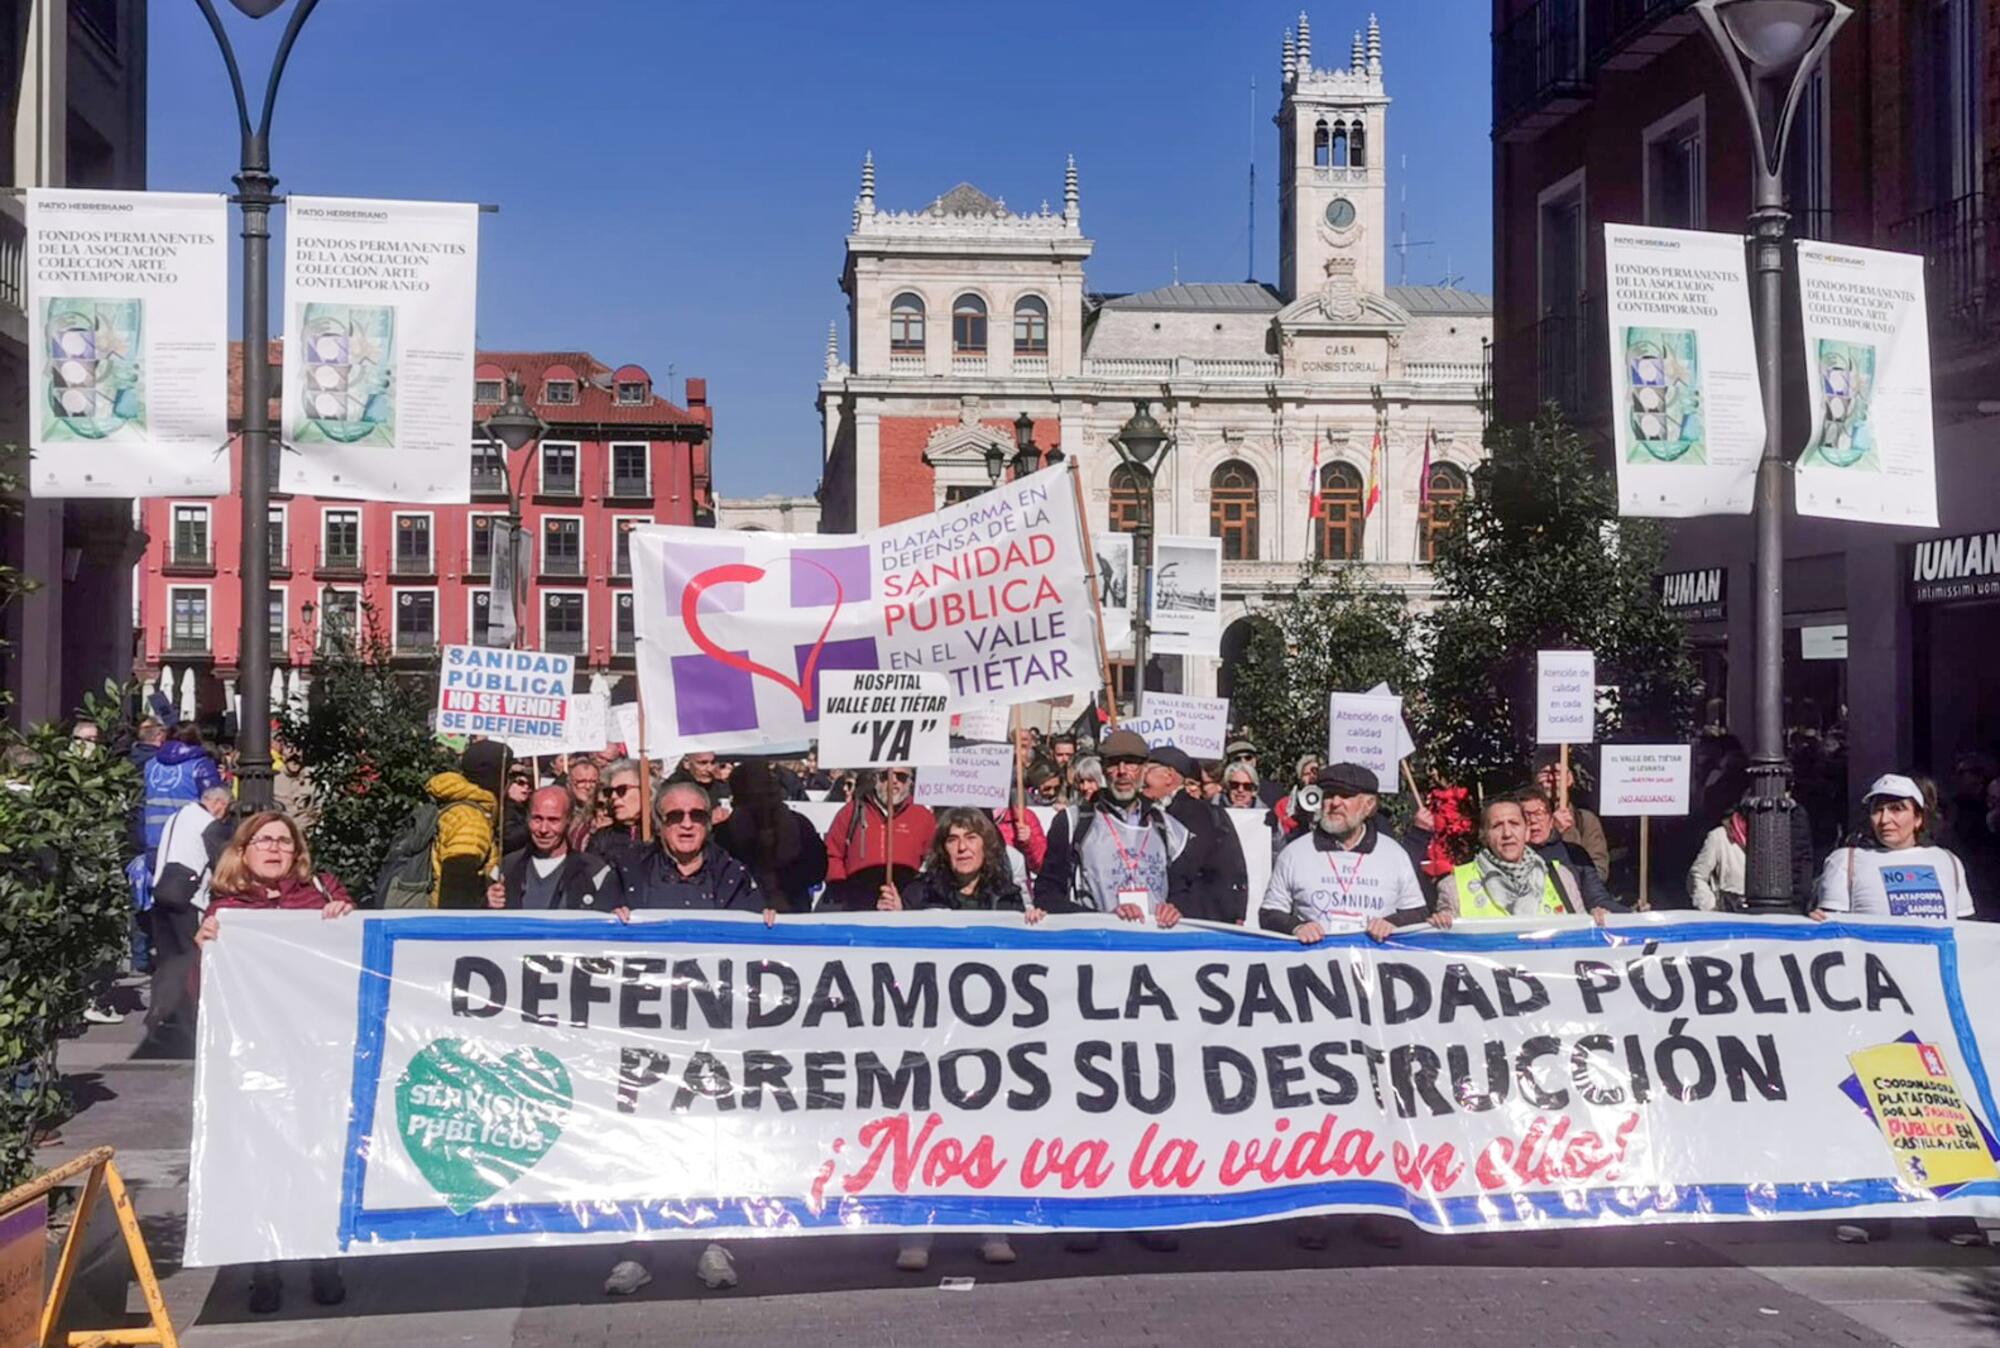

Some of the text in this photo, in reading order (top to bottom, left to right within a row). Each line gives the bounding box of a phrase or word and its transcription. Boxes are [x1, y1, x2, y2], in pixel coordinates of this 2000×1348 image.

[38, 202, 67, 210] PATIO
[297, 208, 325, 217] PATIO
[38, 230, 215, 244] FONDOS PERMANENTES
[38, 243, 60, 255] DE
[61, 244, 80, 255] LA
[297, 237, 467, 255] FONDOS PERMANENTES
[127, 258, 166, 270] ARTE
[296, 251, 317, 262] DE
[319, 251, 336, 262] LA
[381, 267, 418, 279] ARTE
[1615, 263, 1740, 282] FONDOS PERMANENTES
[1616, 275, 1632, 286] DE
[1633, 277, 1646, 287] LA
[1681, 292, 1708, 304] ARTE
[1806, 278, 1916, 302] FONDOS PERMANENTES
[1808, 289, 1821, 300] DE
[1822, 290, 1835, 302] LA
[1866, 309, 1888, 321] ARTE
[1324, 345, 1356, 356] CASA
[1301, 361, 1379, 372] CONSISTORIAL
[881, 484, 1048, 555] PLATAFORMA EN
[882, 508, 1051, 572] DEFENSA DE LA
[883, 533, 1056, 598] SANIDAD
[1917, 581, 2000, 601] intimissimi uom
[884, 574, 1064, 637] PÚBLICA
[890, 610, 1067, 671] EN EL VALLE
[448, 647, 569, 674] SANIDAD
[949, 648, 1073, 697] TIÉTAR
[1579, 669, 1590, 678] de
[447, 667, 566, 697] PÚBLICA
[853, 673, 921, 691] HOSPITAL
[1551, 684, 1581, 693] calidad
[450, 690, 475, 711] NO
[478, 691, 501, 713] SE
[504, 695, 562, 719] VENDE
[826, 692, 947, 714] VALLE DEL TIÉTAR
[1562, 700, 1582, 708] cada
[1336, 710, 1395, 723] Atención de
[442, 713, 466, 729] SE
[471, 715, 563, 738] DEFIENDE
[1103, 716, 1176, 737] SNIDAD
[1347, 728, 1382, 738] calidad
[1345, 745, 1383, 755] en cada
[956, 757, 969, 765] EN
[970, 758, 1001, 767] LUCHA
[918, 782, 1006, 800] NO SE NOS ESCUCHA
[1883, 871, 1905, 884] NO
[1332, 891, 1385, 910] SANIDAD
[451, 941, 1914, 1030] DEFENDAMOS LA SANIDAD PÚBLICA
[617, 1018, 1788, 1119] PAREMOS SU DESTRUCCIÓN
[1878, 1091, 1961, 1109] PLATAFORMAS
[1883, 1106, 1906, 1118] POR
[1908, 1106, 1923, 1118] LA
[1956, 1123, 1975, 1139] EN
[1894, 1136, 1945, 1150] CASTILLA
[1020, 1136, 1115, 1190] va
[1128, 1122, 1205, 1190] la
[1218, 1113, 1385, 1187] vida
[1392, 1139, 1466, 1193] en
